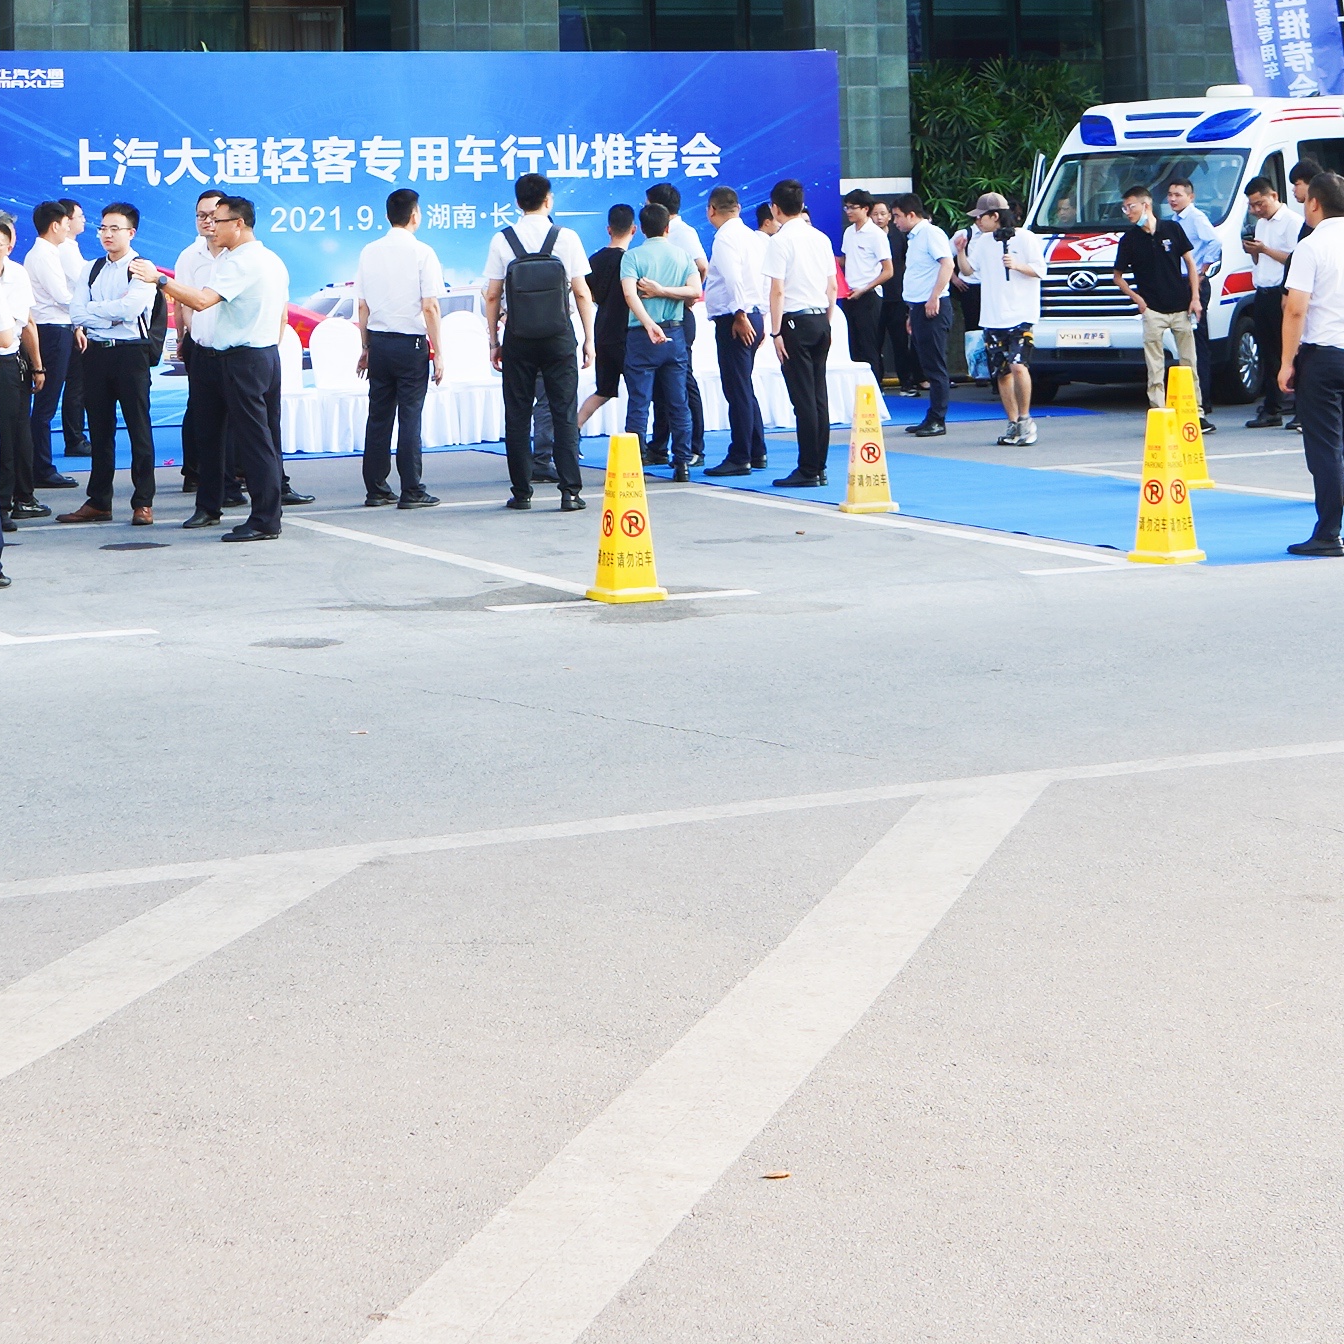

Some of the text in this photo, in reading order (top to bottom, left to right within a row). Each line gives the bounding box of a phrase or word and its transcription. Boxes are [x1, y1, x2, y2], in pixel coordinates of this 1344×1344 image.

[61, 132, 722, 186] 上汽大通轻客专用车行业推荐会
[270, 205, 383, 233] 2021.9.
[617, 550, 653, 568] 请勿泊车
